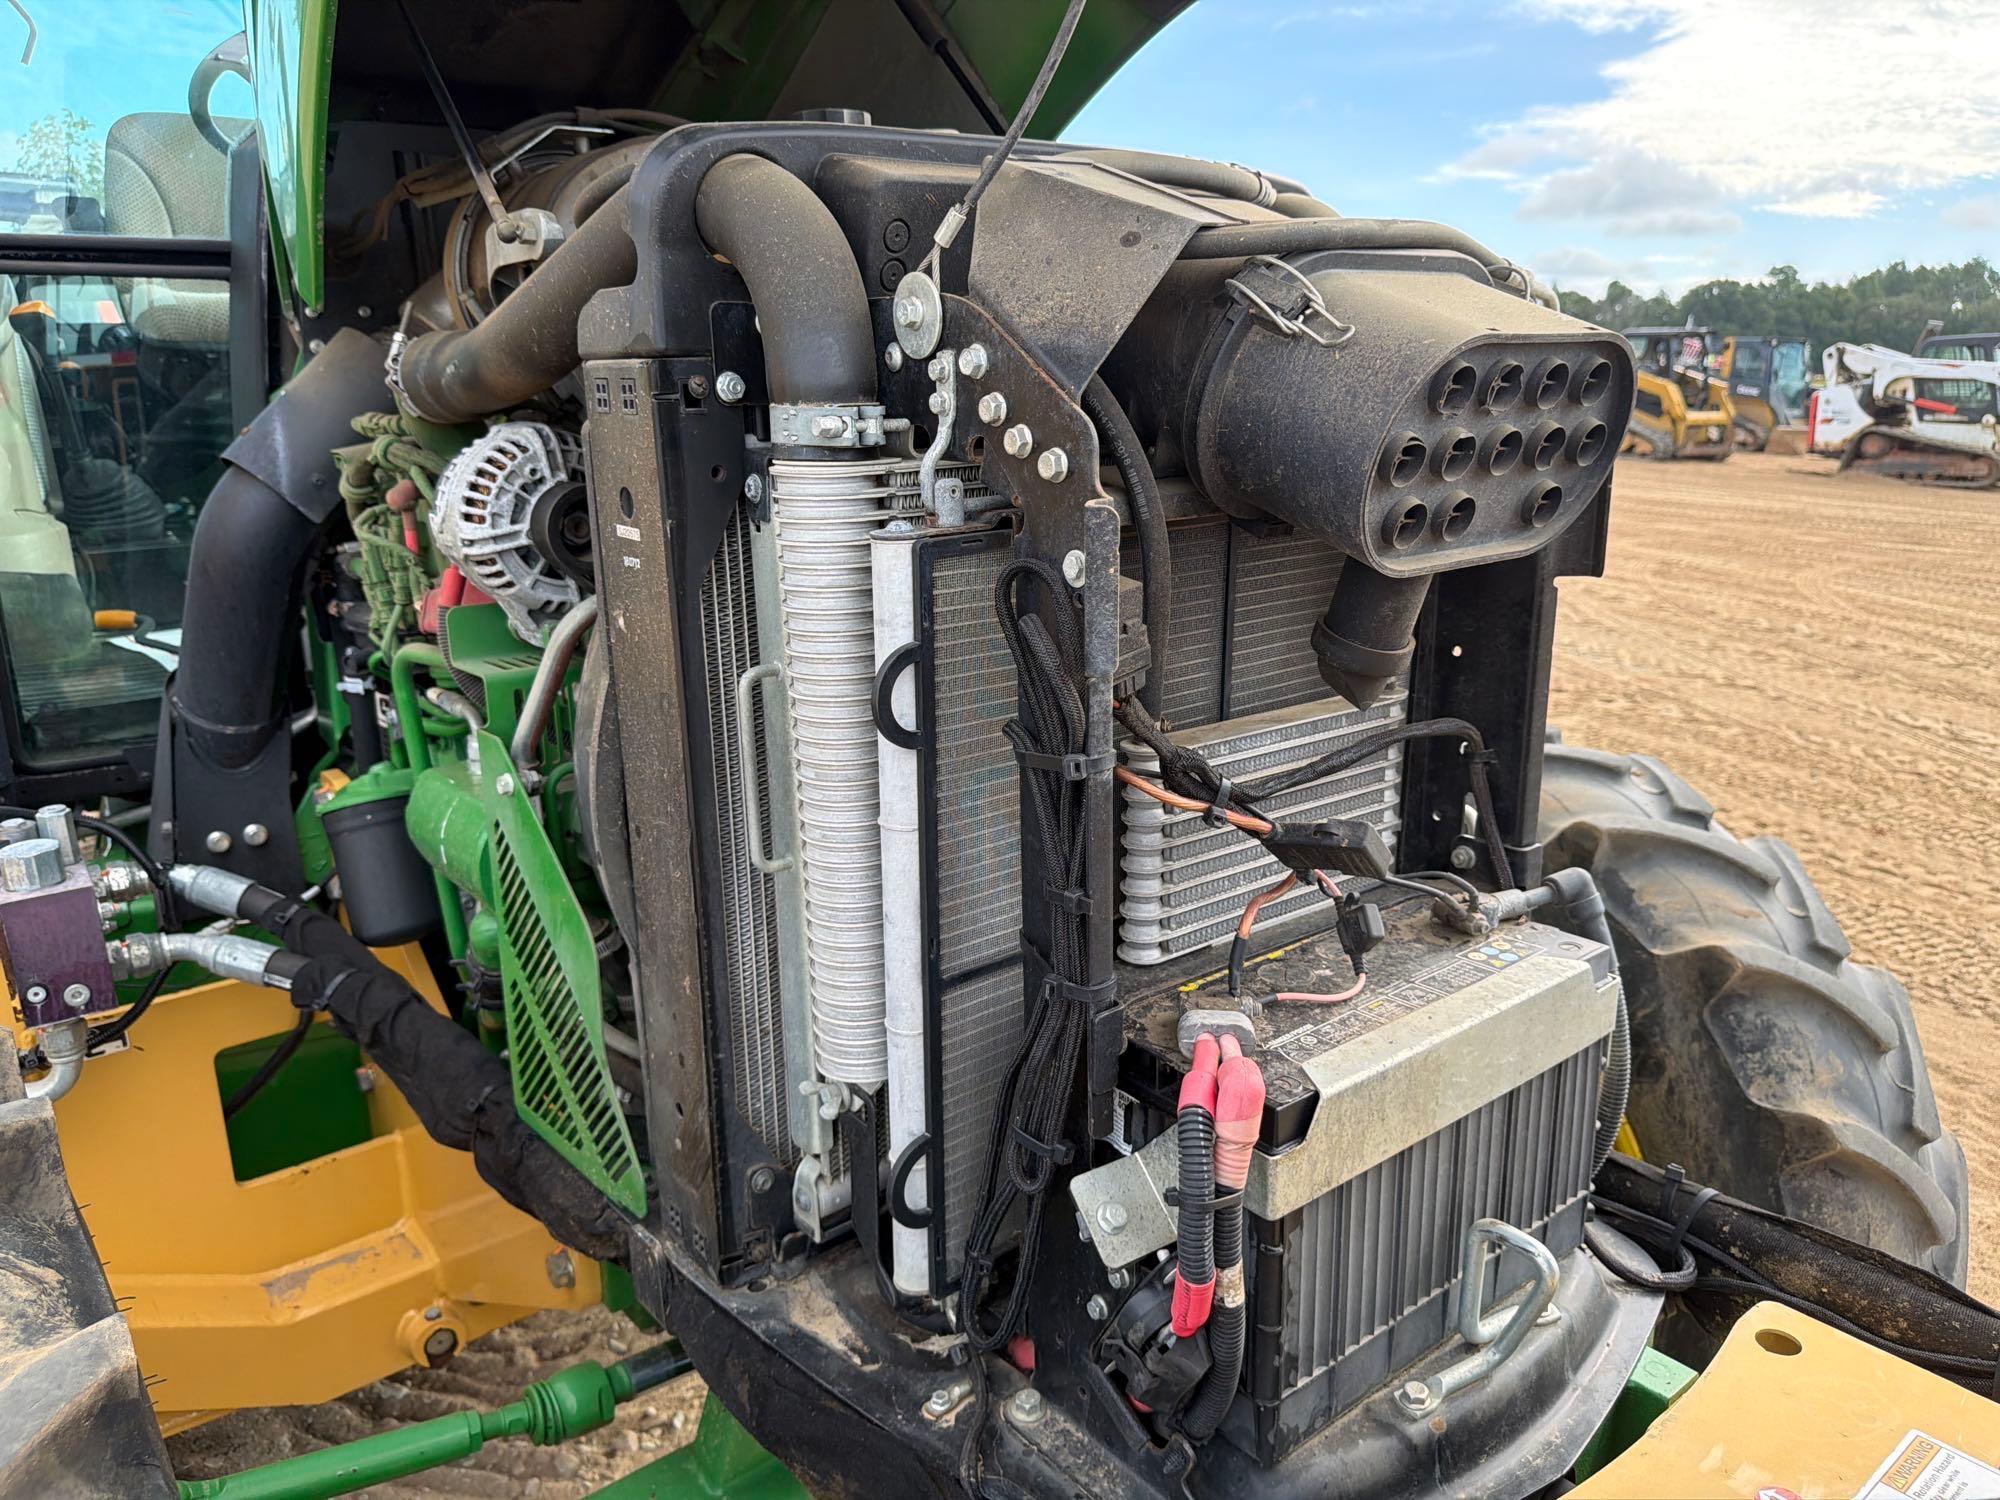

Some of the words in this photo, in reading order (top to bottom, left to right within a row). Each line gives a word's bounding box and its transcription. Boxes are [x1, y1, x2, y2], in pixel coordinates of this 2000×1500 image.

[1113, 439, 1131, 466] 2018
[1894, 1440, 1934, 1480] WARNING
[1912, 1473, 1939, 1499] Rotation
[1932, 1452, 1956, 1475] Hazard
